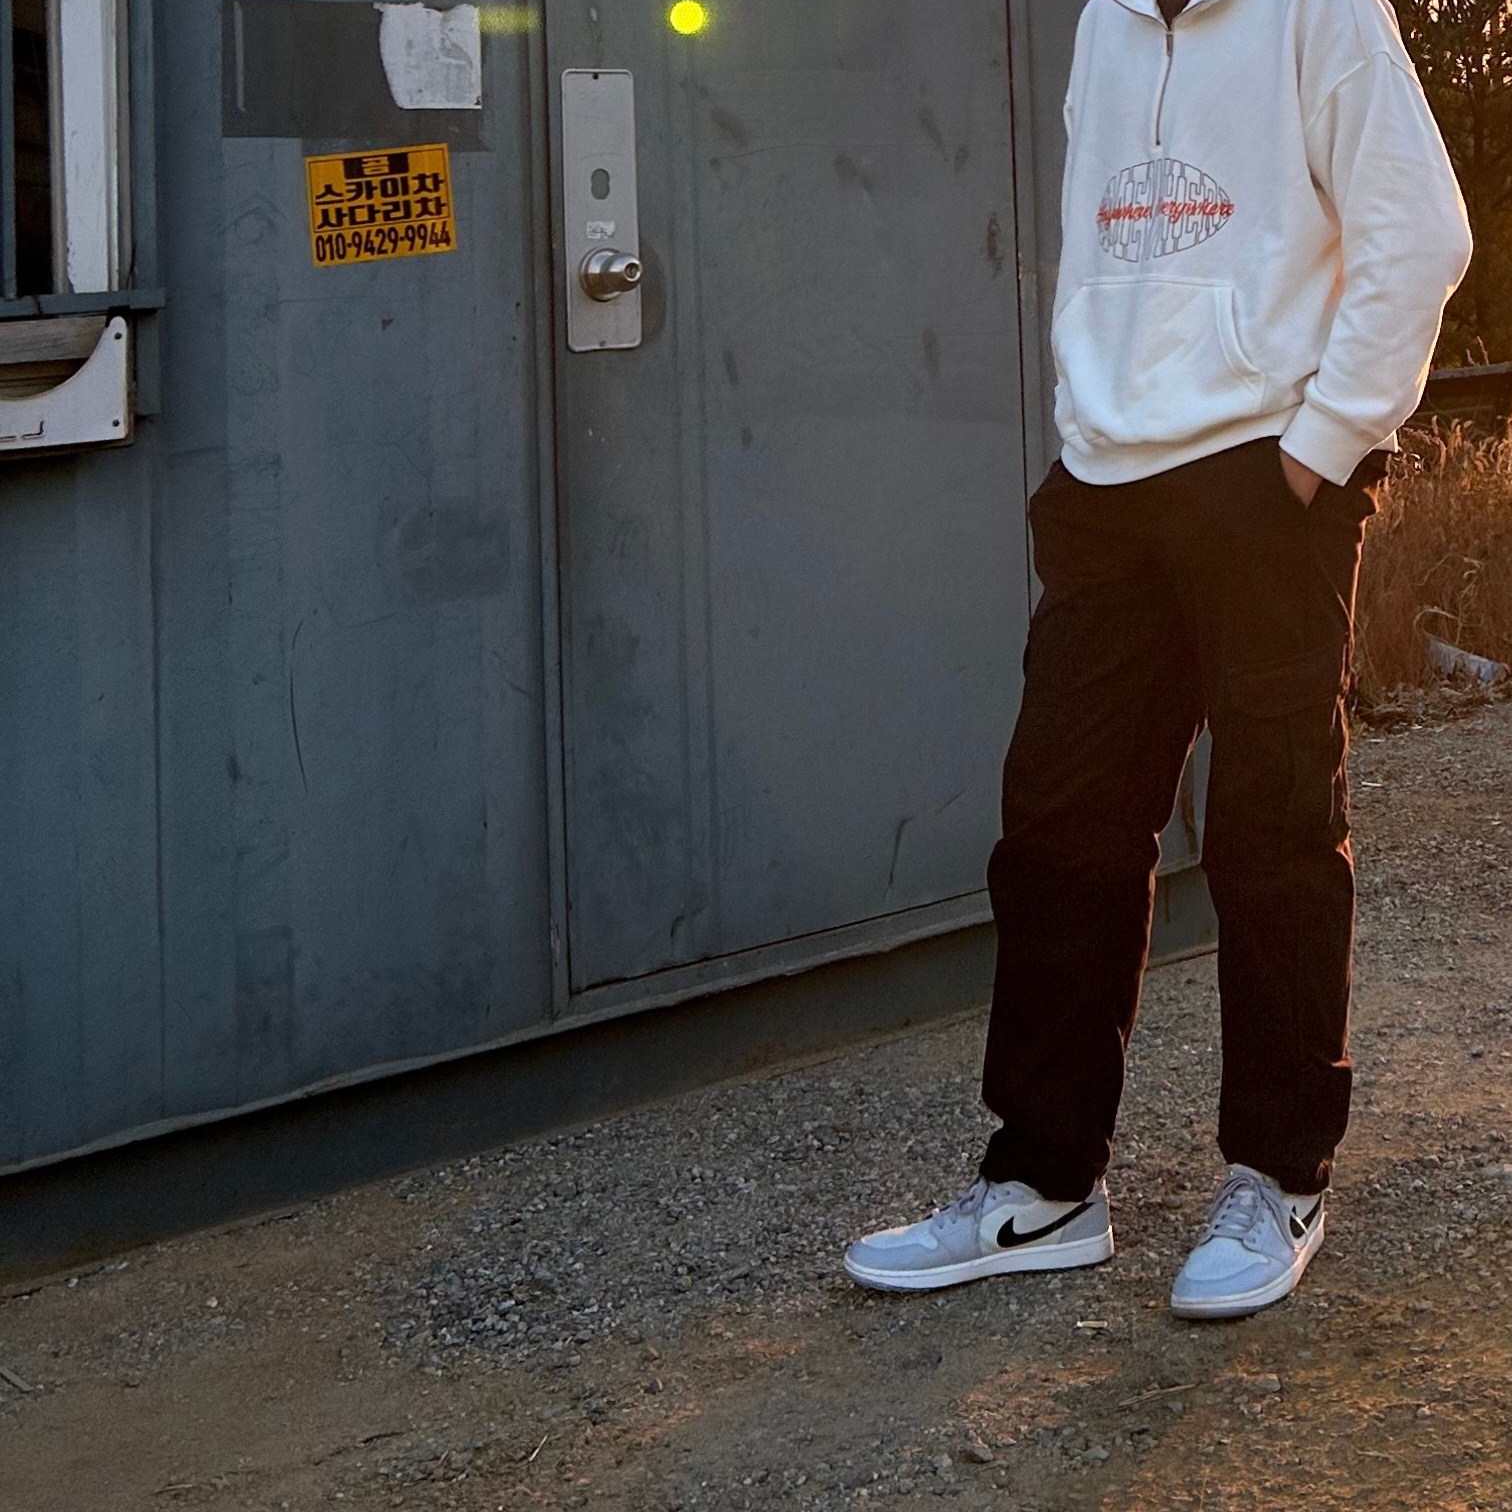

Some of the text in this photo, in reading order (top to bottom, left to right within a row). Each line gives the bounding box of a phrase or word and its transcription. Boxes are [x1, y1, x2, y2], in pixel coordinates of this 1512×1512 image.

[315, 173, 445, 206] 스카이차
[317, 196, 447, 230] 사다리차
[316, 221, 451, 262] 010-9429-9944
